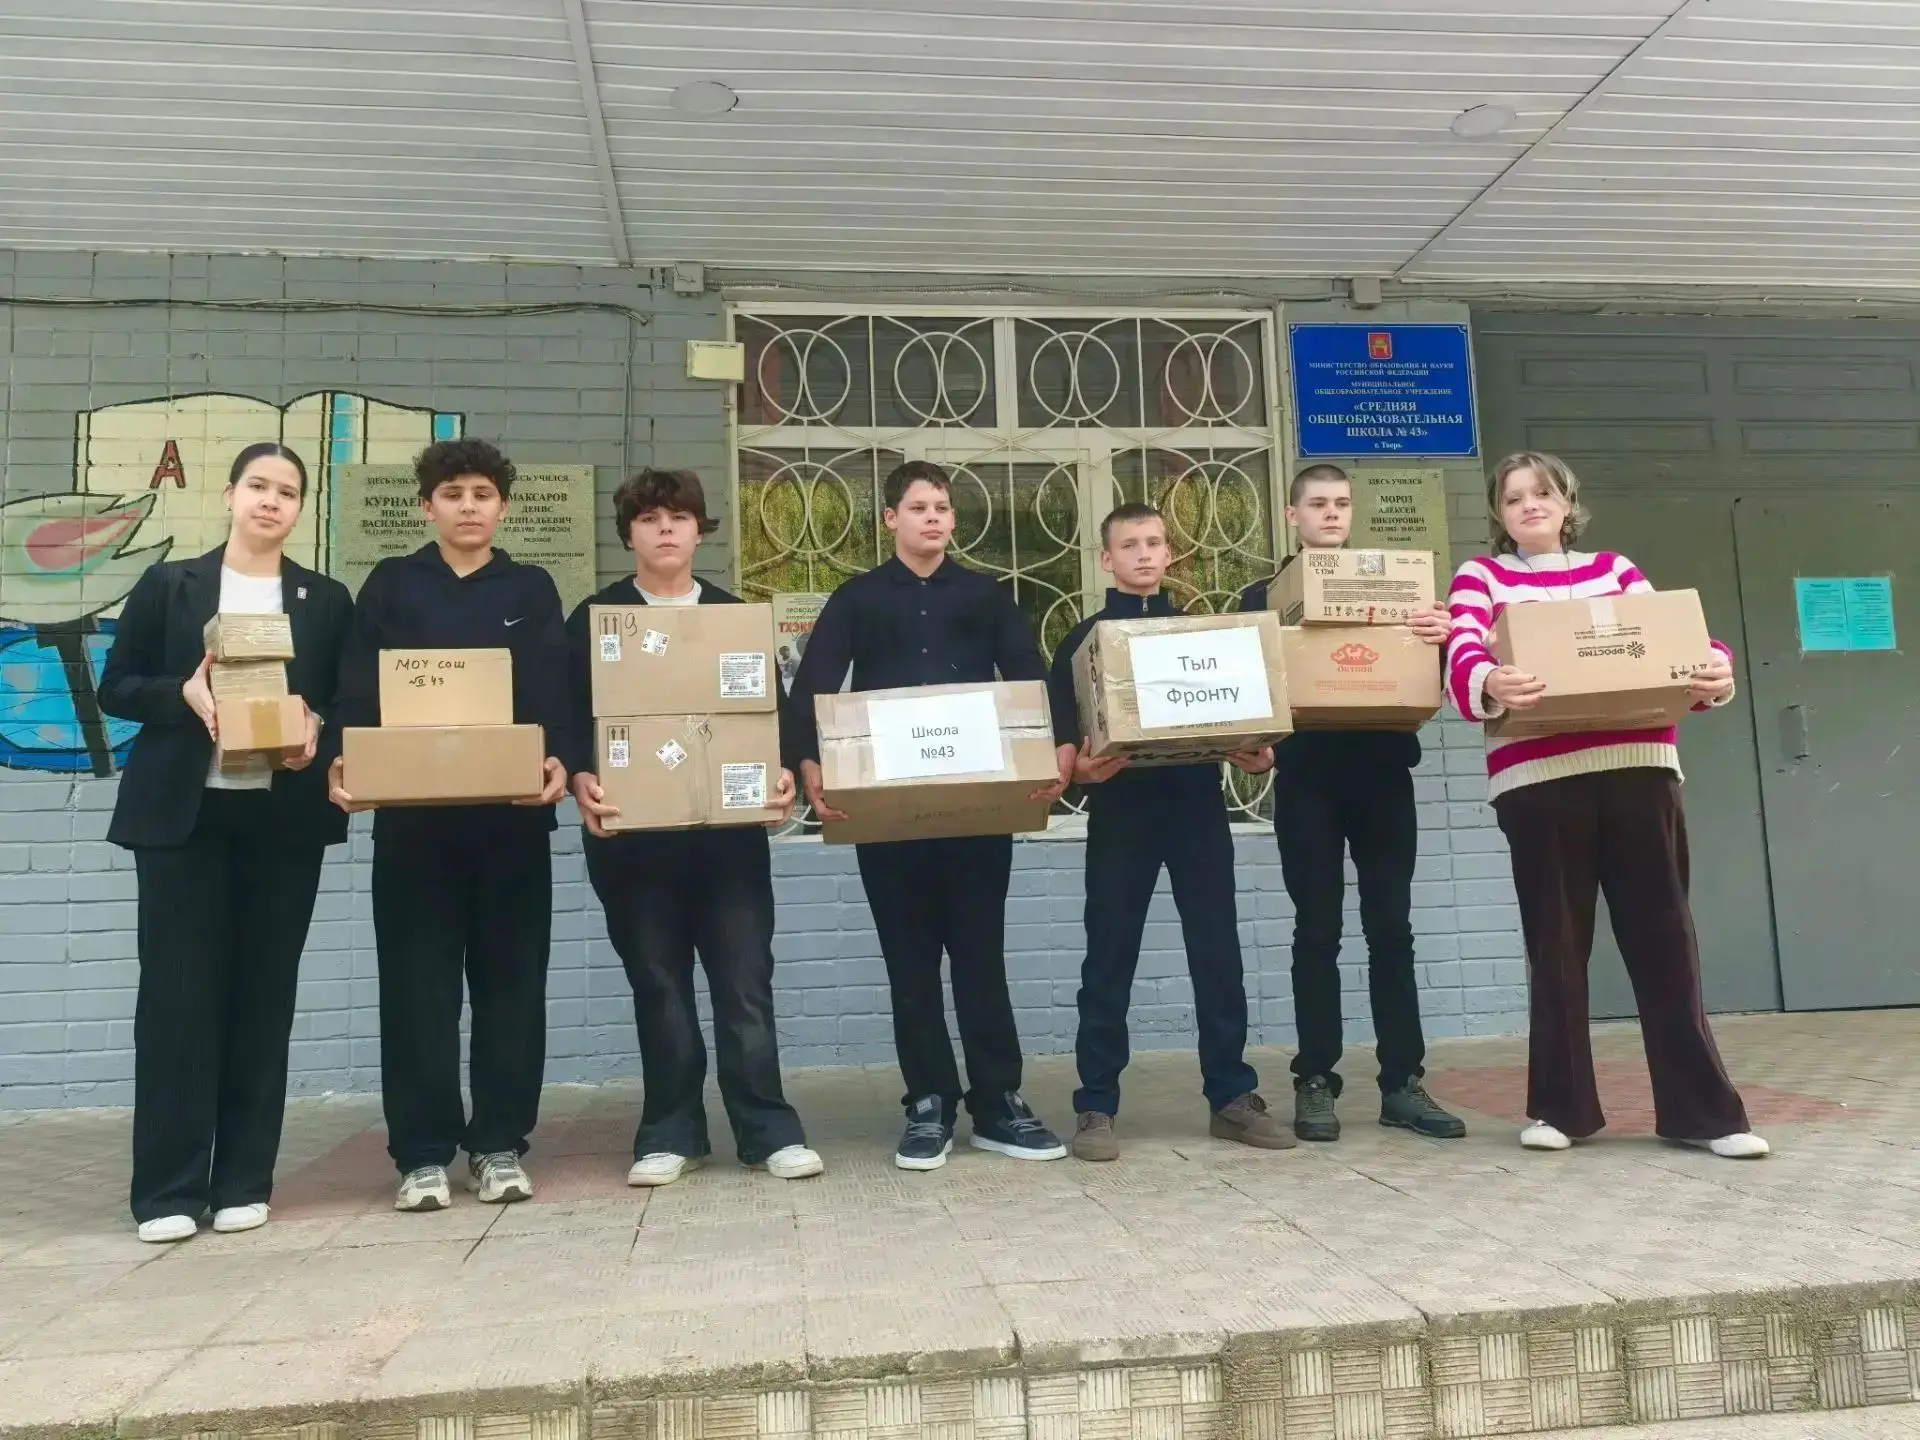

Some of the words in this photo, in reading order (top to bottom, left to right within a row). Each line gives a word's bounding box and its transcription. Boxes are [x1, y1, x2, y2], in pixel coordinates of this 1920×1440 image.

[1335, 368, 1385, 376] РОССИЙСКОЙ
[1353, 401, 1417, 412] «СРЕДНЯЯ
[1308, 414, 1463, 425] ОБЩЕОБРАЗОВАТЕЛЬНАЯ
[1346, 427, 1392, 437] ШКОЛА
[1395, 427, 1407, 437] №
[1409, 427, 1428, 437] 43»
[150, 439, 186, 489] А
[508, 493, 568, 502] МАКСАРОВ
[1380, 495, 1413, 504] МОРОЗ
[381, 509, 408, 517] ИВАН
[521, 505, 554, 513] ДЕНИС
[1379, 506, 1416, 514] АЛЕКСЕЙ
[362, 519, 427, 528] ВАСИЛЬЕВИЧ
[503, 516, 572, 524] ГЕННАДЬЕВИЧ
[1308, 553, 1340, 561] FERRERO
[1308, 560, 1340, 568] ROCHER
[395, 658, 430, 671] МОУ
[1177, 655, 1218, 672] Тыл
[1166, 685, 1240, 707] Фронту
[911, 724, 960, 739] Школа
[920, 744, 956, 760] №43
